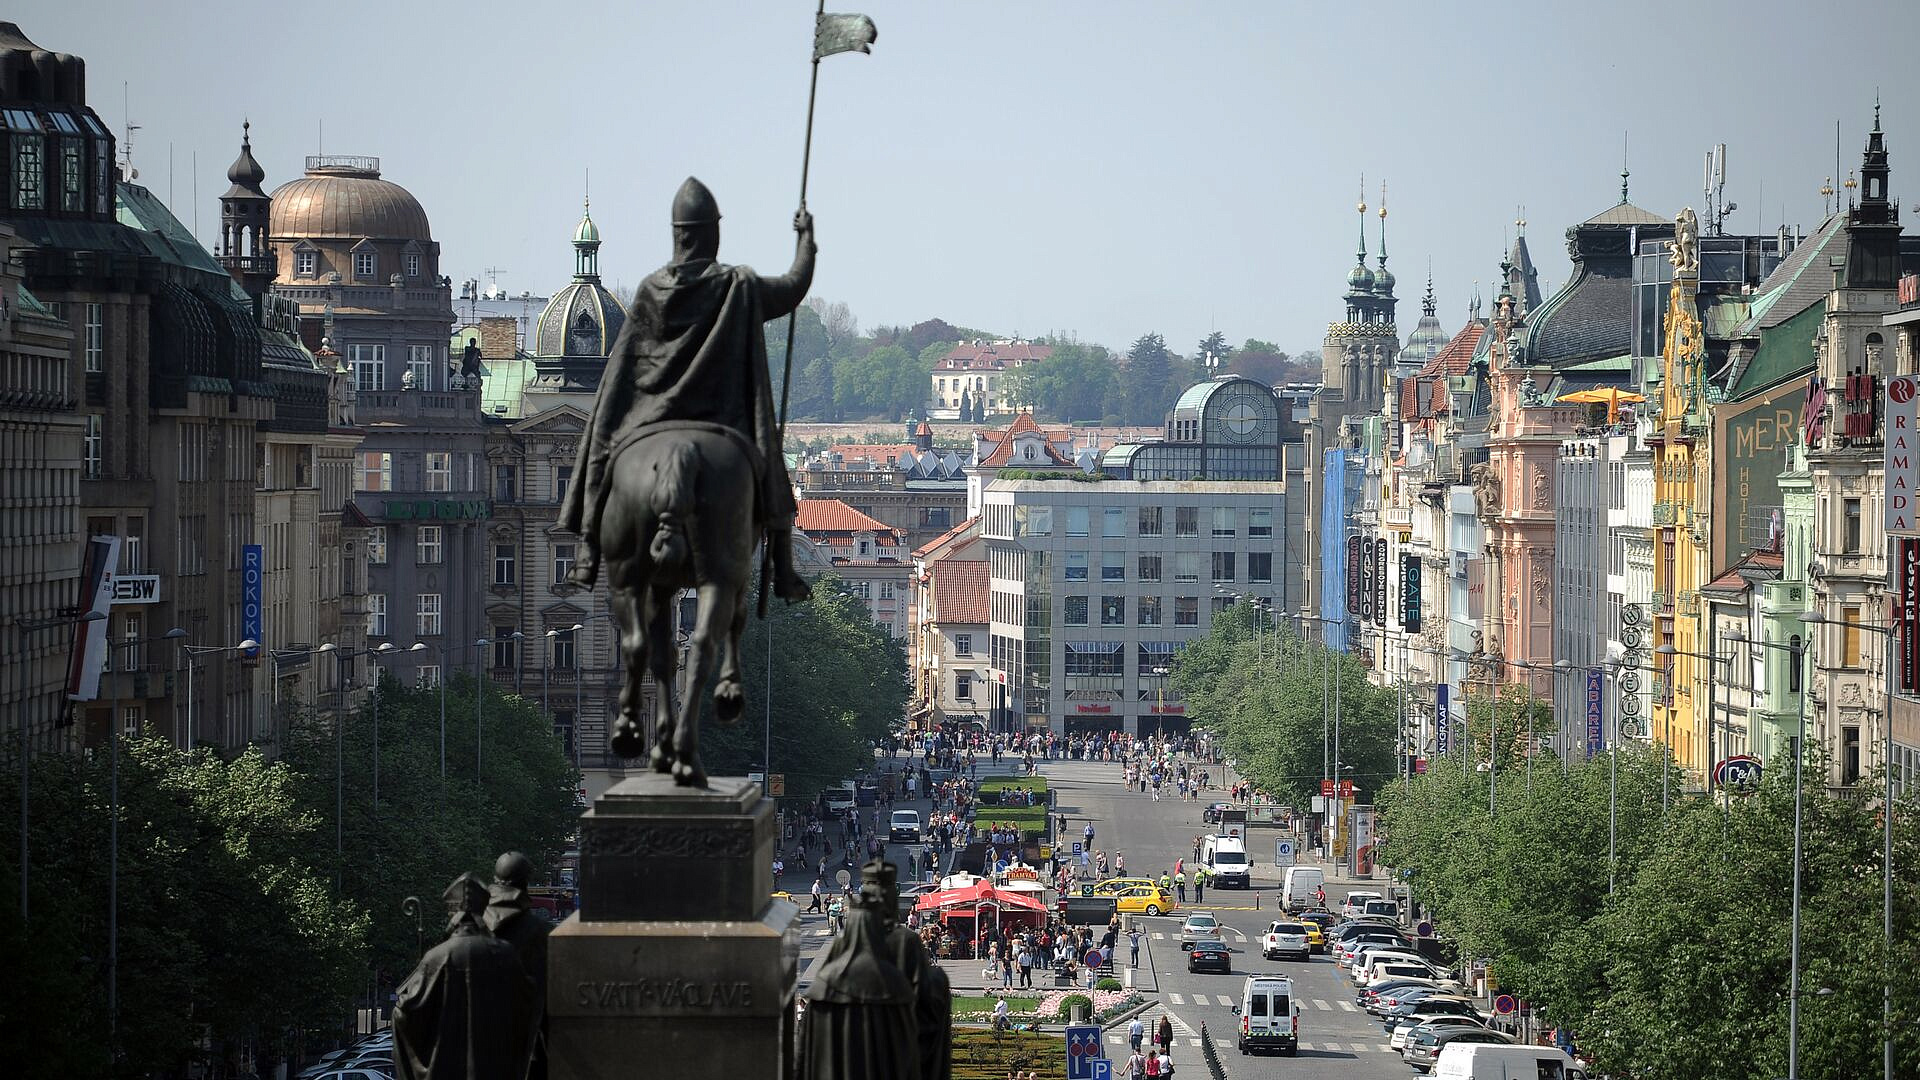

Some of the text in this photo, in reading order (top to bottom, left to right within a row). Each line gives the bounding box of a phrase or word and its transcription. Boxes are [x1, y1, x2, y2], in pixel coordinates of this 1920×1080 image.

[1892, 416, 1908, 529] RAMADA
[1739, 467, 1749, 544] HOTEL
[1363, 542, 1372, 615] CASINO
[1408, 567, 1419, 620] GATE
[1728, 766, 1759, 785] C&A
[1095, 1062, 1108, 1079] P
